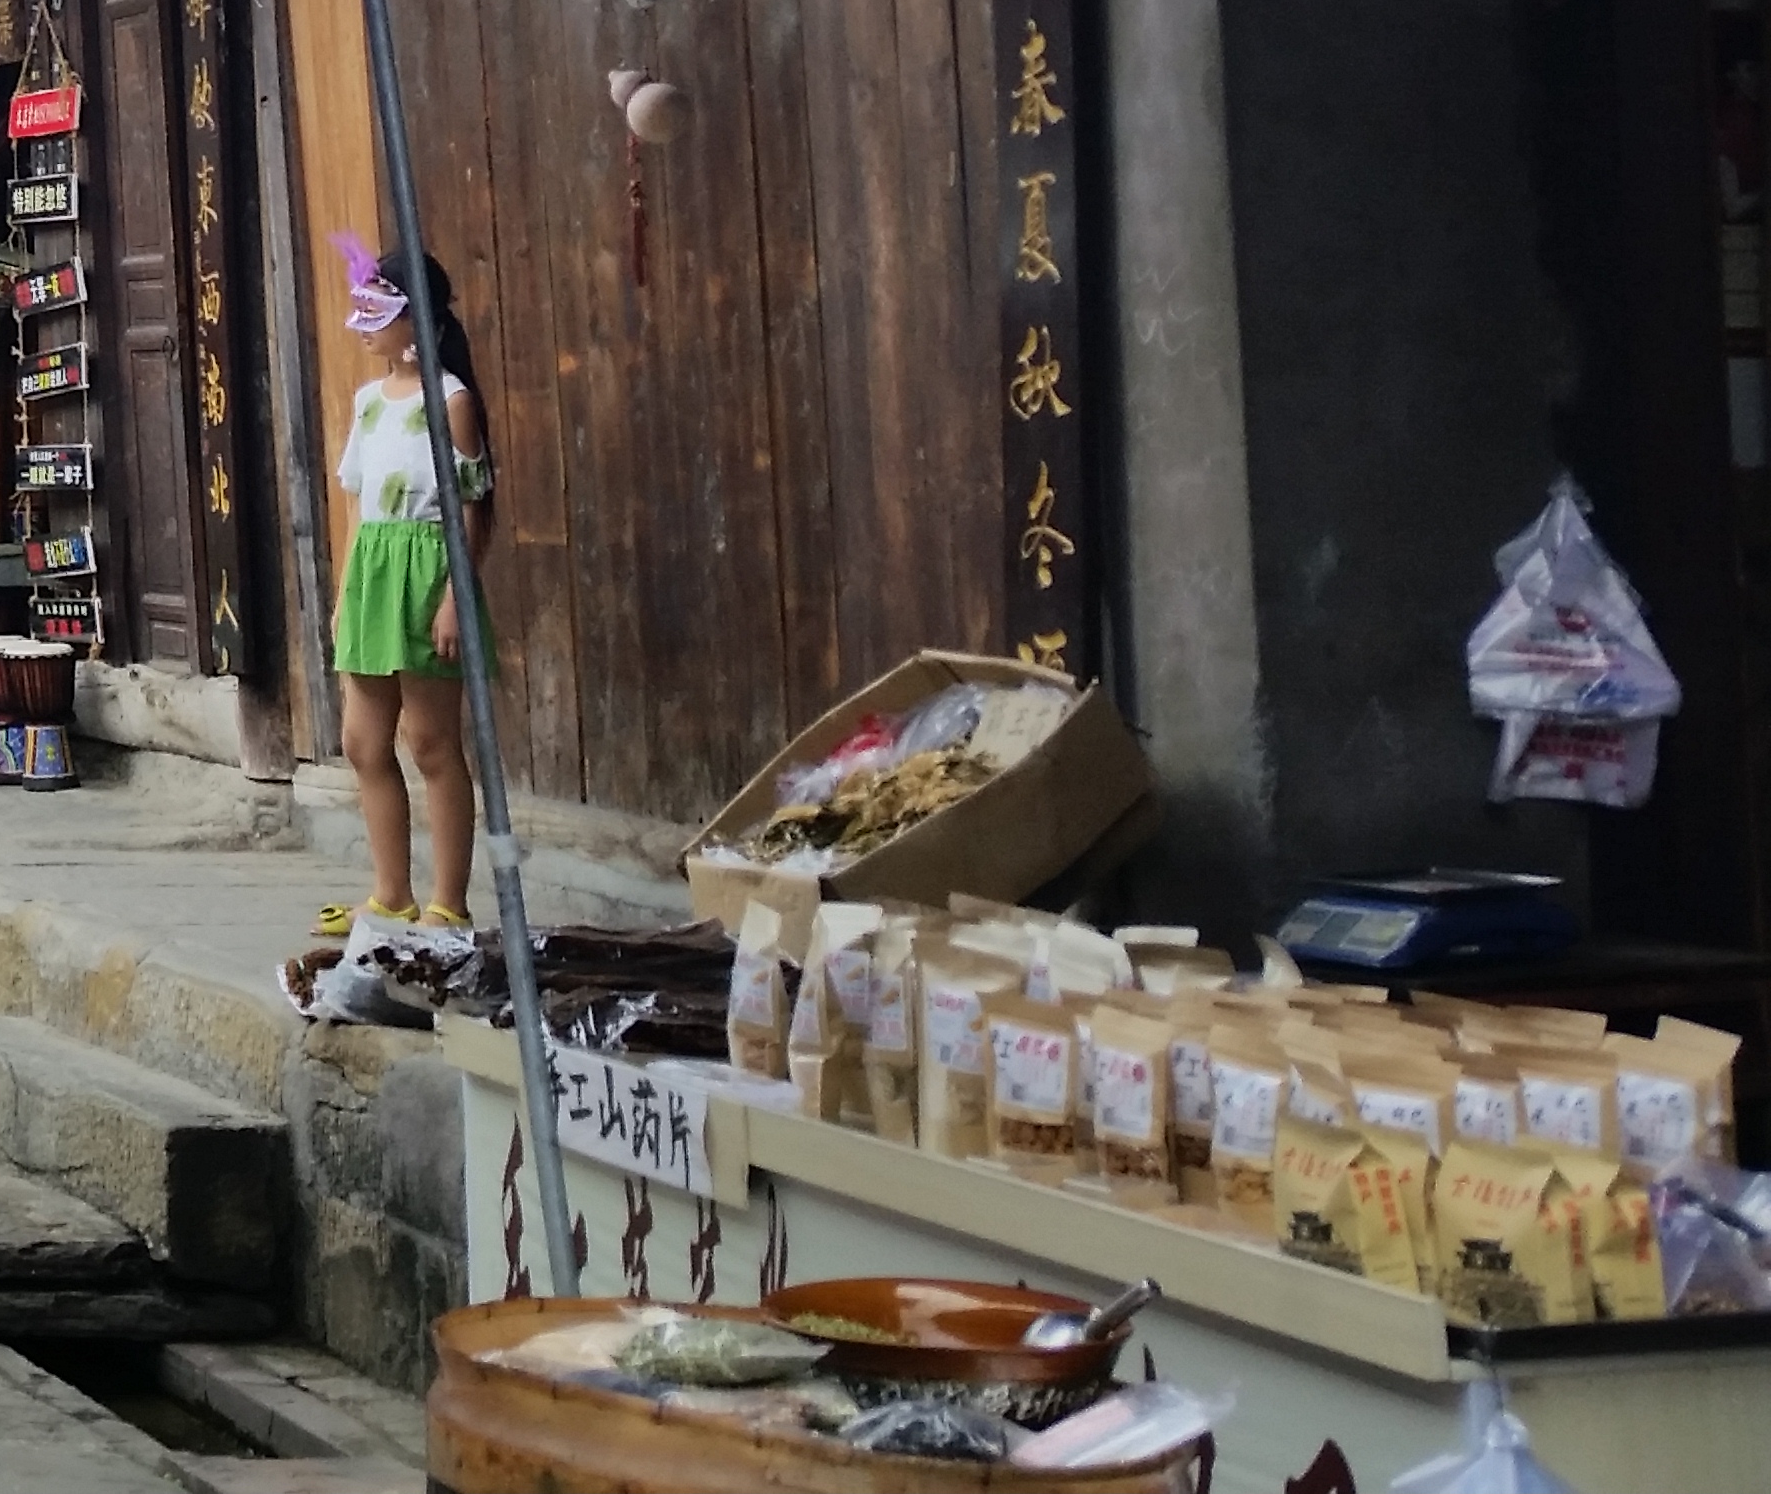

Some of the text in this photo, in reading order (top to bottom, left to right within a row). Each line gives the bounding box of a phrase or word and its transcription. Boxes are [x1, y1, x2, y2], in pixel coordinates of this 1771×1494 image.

[12, 182, 68, 215] 特别能忽悠
